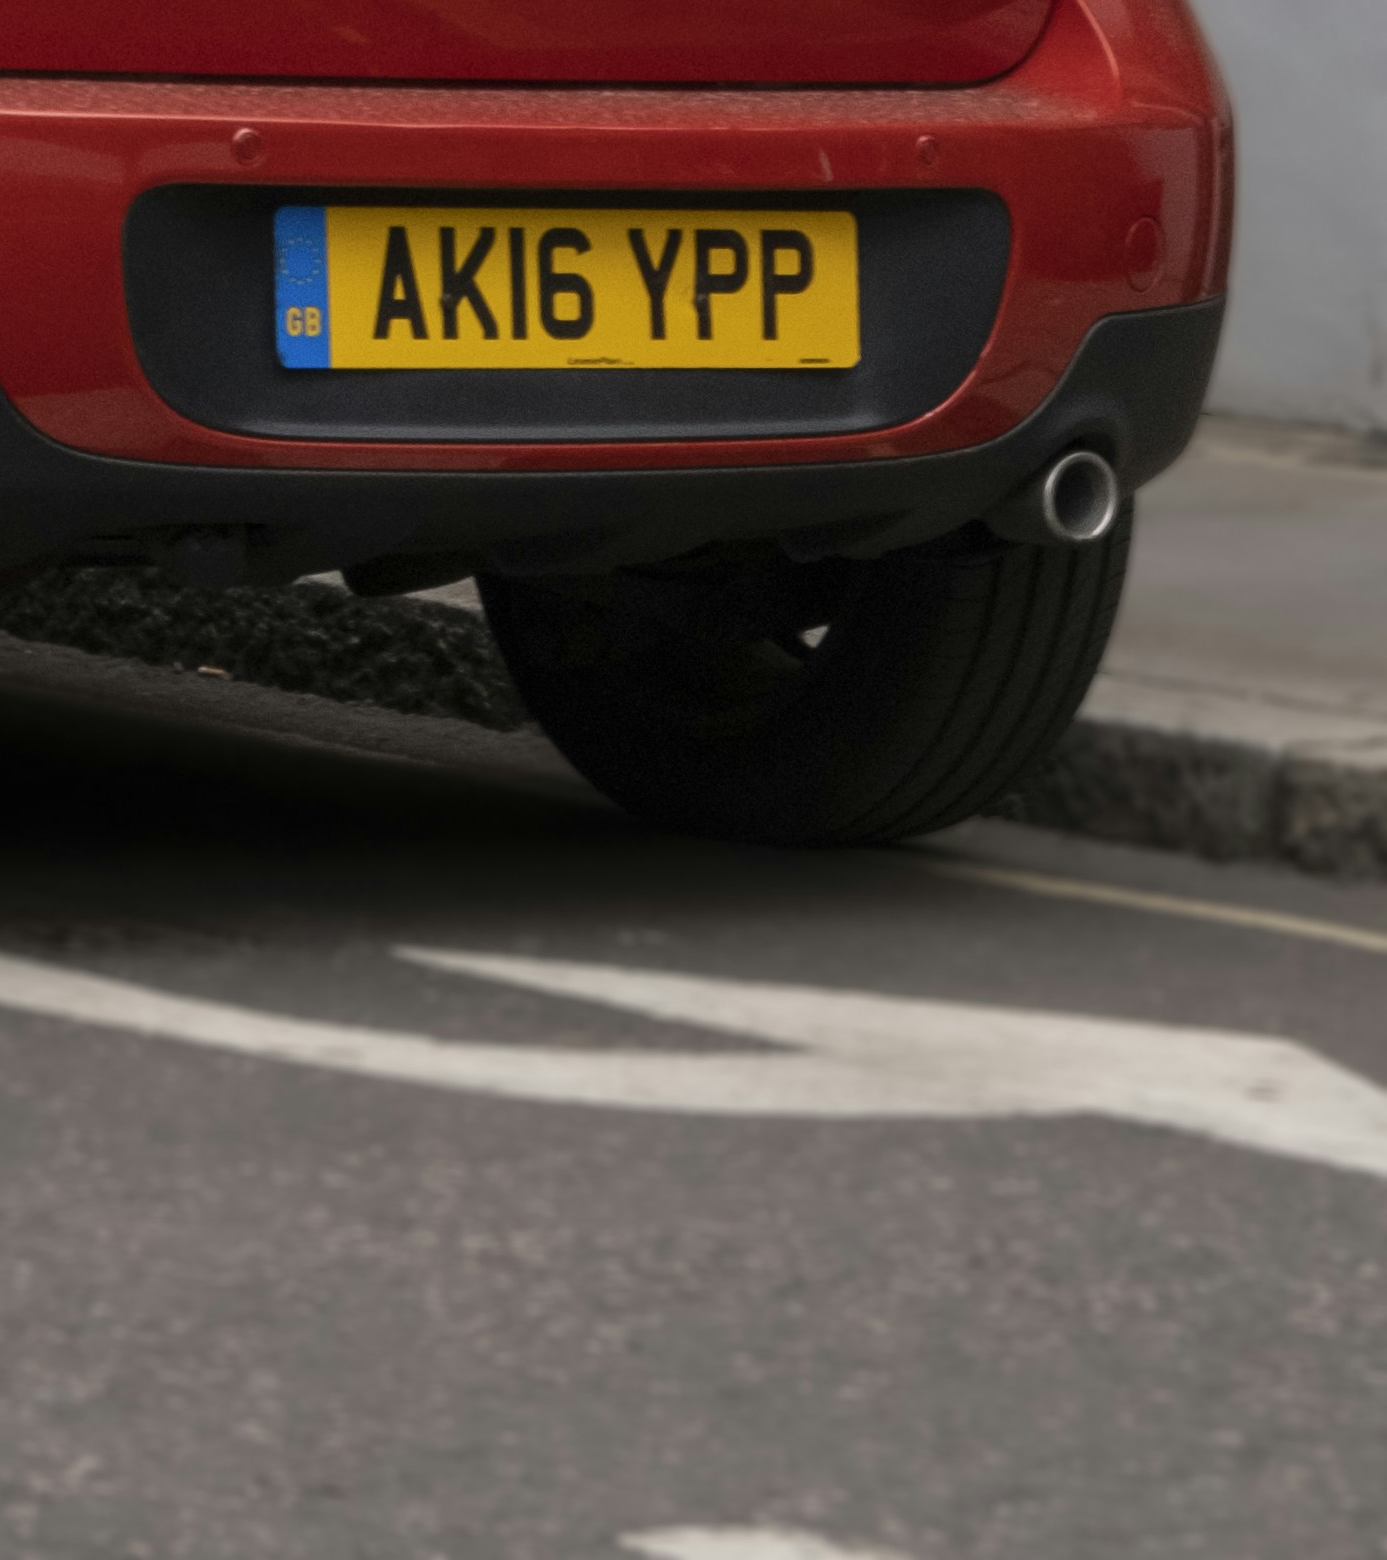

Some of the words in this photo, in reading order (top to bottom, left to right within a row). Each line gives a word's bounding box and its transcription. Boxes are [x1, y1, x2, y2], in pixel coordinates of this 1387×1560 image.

[372, 226, 595, 341] AK16
[629, 228, 815, 341] YPP
[286, 306, 321, 337] GB
